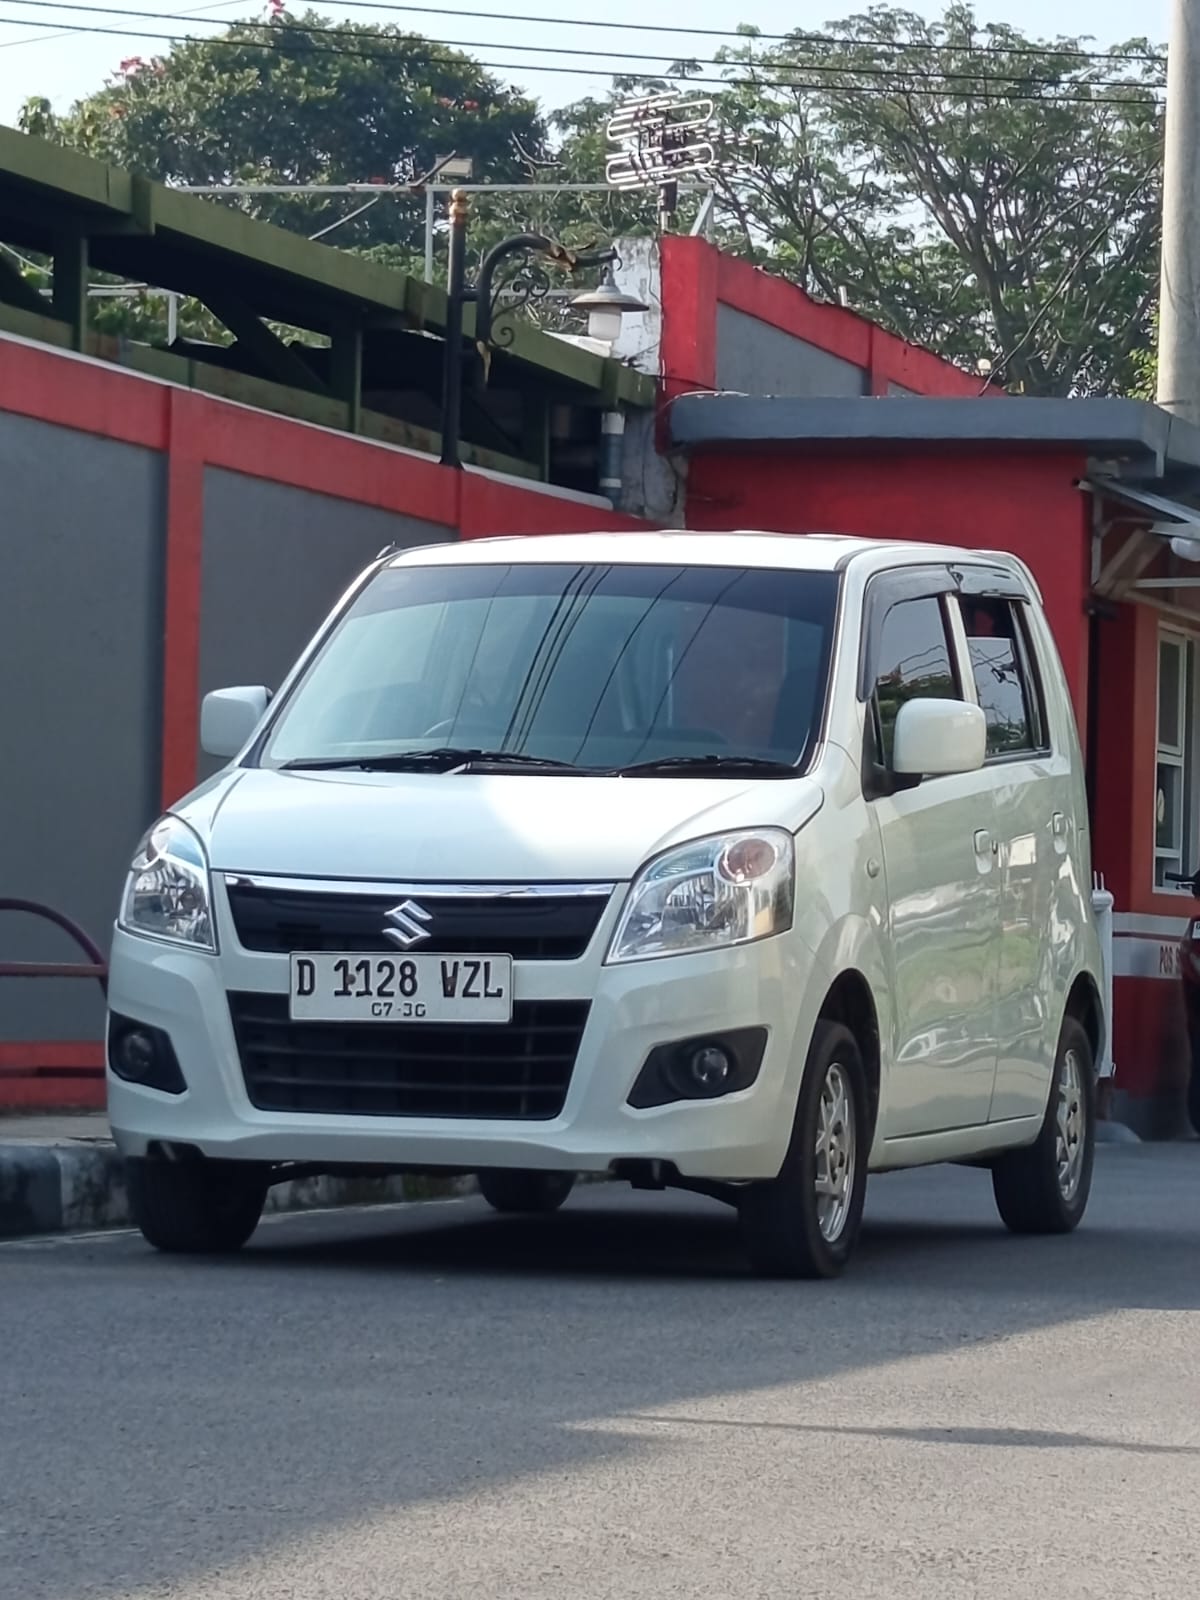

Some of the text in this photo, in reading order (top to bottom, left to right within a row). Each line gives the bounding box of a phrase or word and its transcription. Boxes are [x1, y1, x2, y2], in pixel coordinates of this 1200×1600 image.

[296, 959, 503, 998] D 1128 VZL
